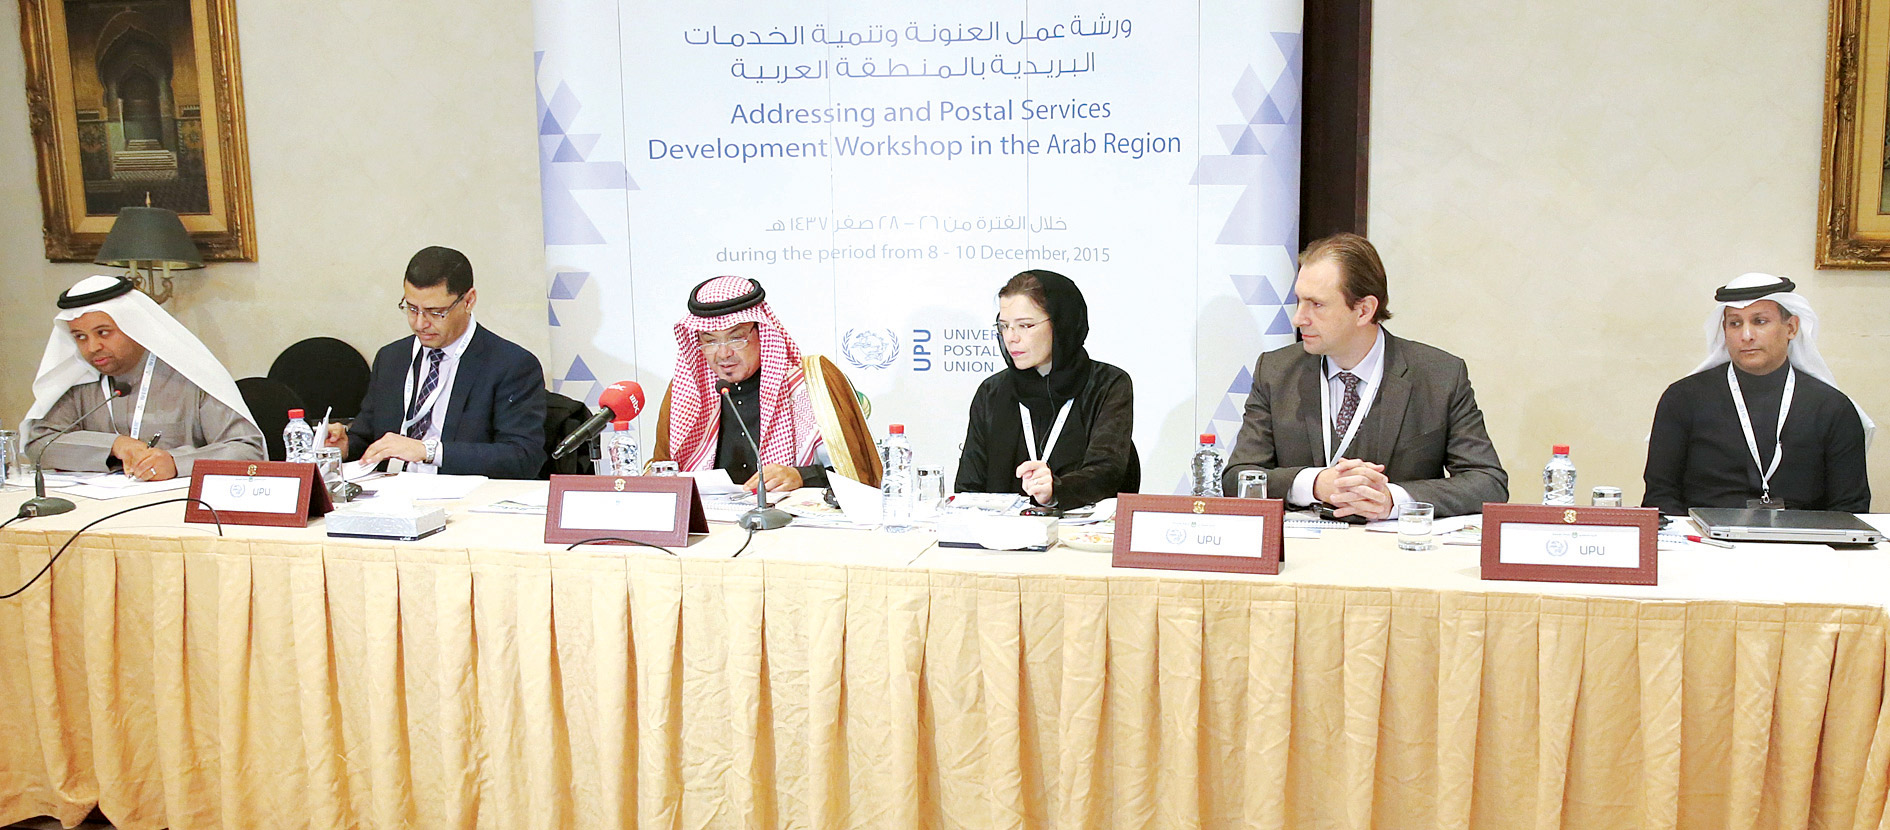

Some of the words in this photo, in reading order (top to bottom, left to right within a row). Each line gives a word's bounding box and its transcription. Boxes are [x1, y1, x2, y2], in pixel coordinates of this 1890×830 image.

[684, 25, 804, 47] الخدمات
[811, 24, 898, 48] وتنمية
[905, 21, 999, 46] العنونة
[1006, 20, 1065, 45] عمل
[1070, 13, 1132, 39] ورشة
[731, 58, 828, 83] العربية
[836, 56, 985, 80] بالمنطقة
[991, 52, 1095, 79] البريدية
[730, 103, 875, 128] Addressing
[884, 101, 931, 122] and
[940, 99, 1013, 121] Postal
[1021, 98, 1111, 120] Services
[649, 137, 828, 163] Development
[835, 135, 963, 160] Workshop
[971, 135, 992, 155] in
[1000, 133, 1040, 155] the
[1047, 132, 1097, 154] Arab
[1104, 132, 1181, 159] Region
[790, 217, 828, 231] ١٤٣٧
[834, 215, 874, 233] صفر
[943, 216, 972, 232] من
[976, 215, 1026, 233] الفترة
[1030, 216, 1068, 233] خلال
[716, 247, 777, 265] during
[783, 245, 813, 260] the
[819, 244, 876, 264] period
[881, 244, 923, 259] from
[927, 245, 938, 260] 8
[956, 245, 976, 260] 10
[981, 245, 1070, 263] December,
[1073, 246, 1111, 263] 2015
[944, 329, 998, 341] UNIVER
[913, 329, 932, 372] UPU
[944, 345, 1000, 357] POSTAL
[944, 361, 994, 373] UNION
[629, 394, 640, 414] mbc
[253, 487, 271, 496] UPU
[1197, 535, 1221, 546] UPU
[1579, 545, 1605, 556] UPU
